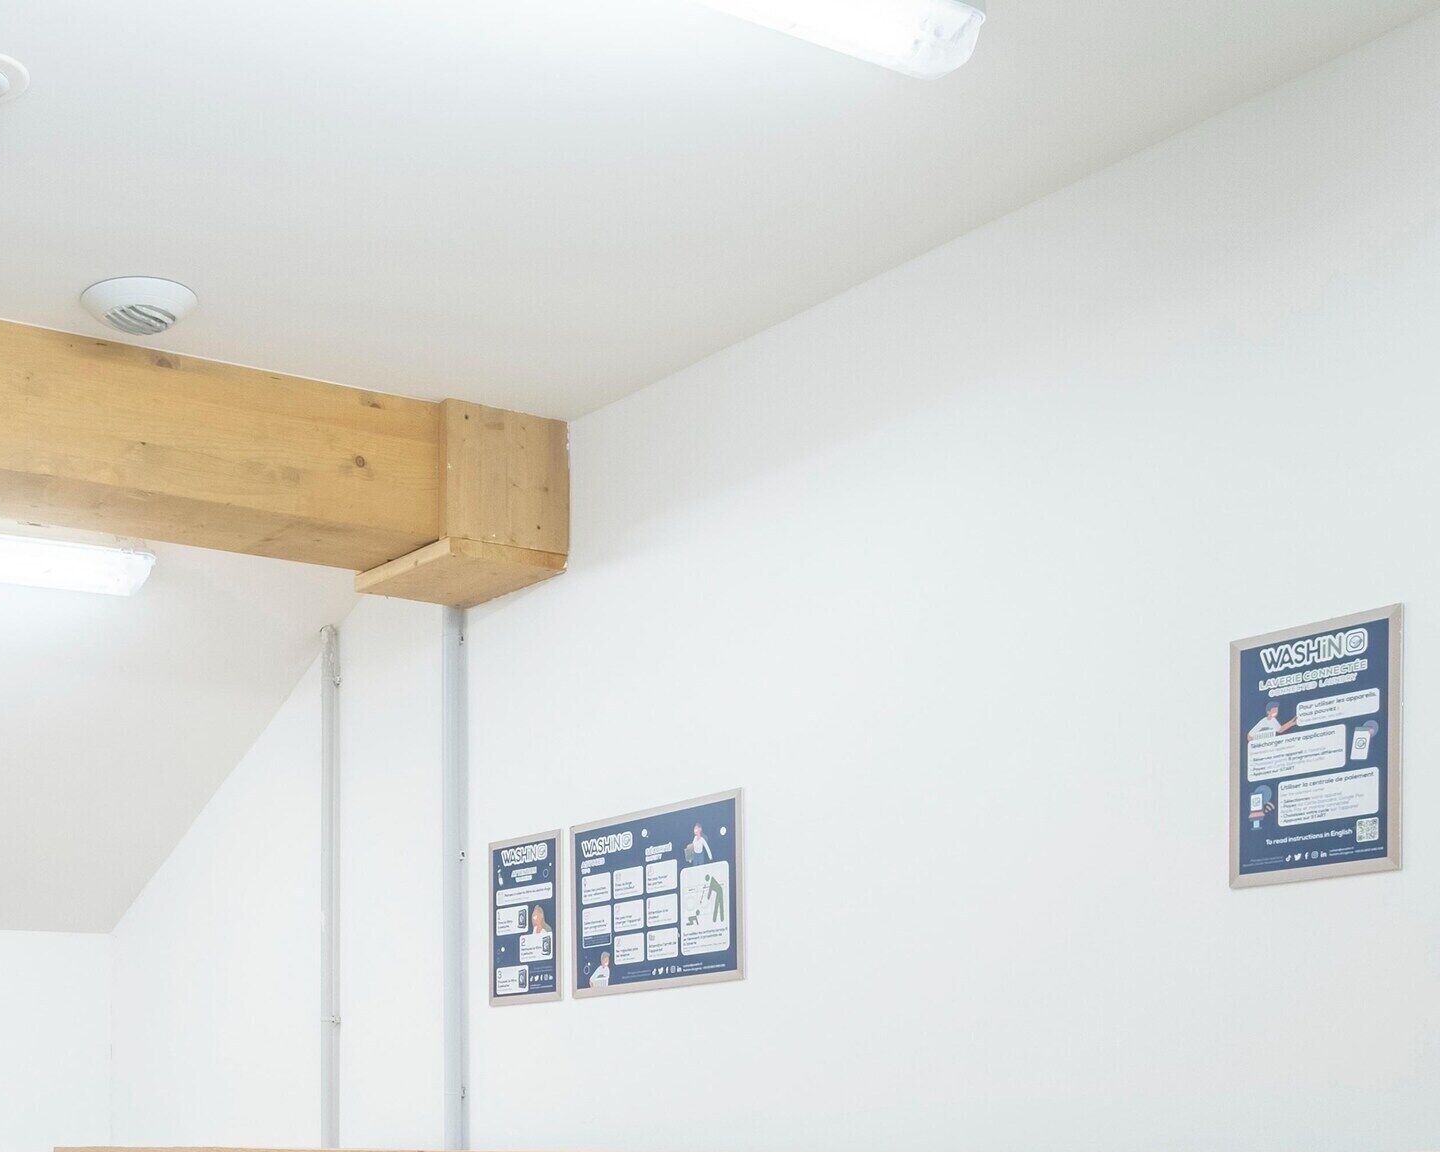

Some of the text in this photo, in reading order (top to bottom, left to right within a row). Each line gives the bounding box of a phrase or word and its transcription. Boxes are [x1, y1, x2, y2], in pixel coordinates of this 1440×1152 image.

[1259, 658, 1368, 691] LAVERIE CONNECTÉE
[1273, 836, 1288, 844] read
[1288, 832, 1324, 842] instructions
[1331, 828, 1353, 839] English
